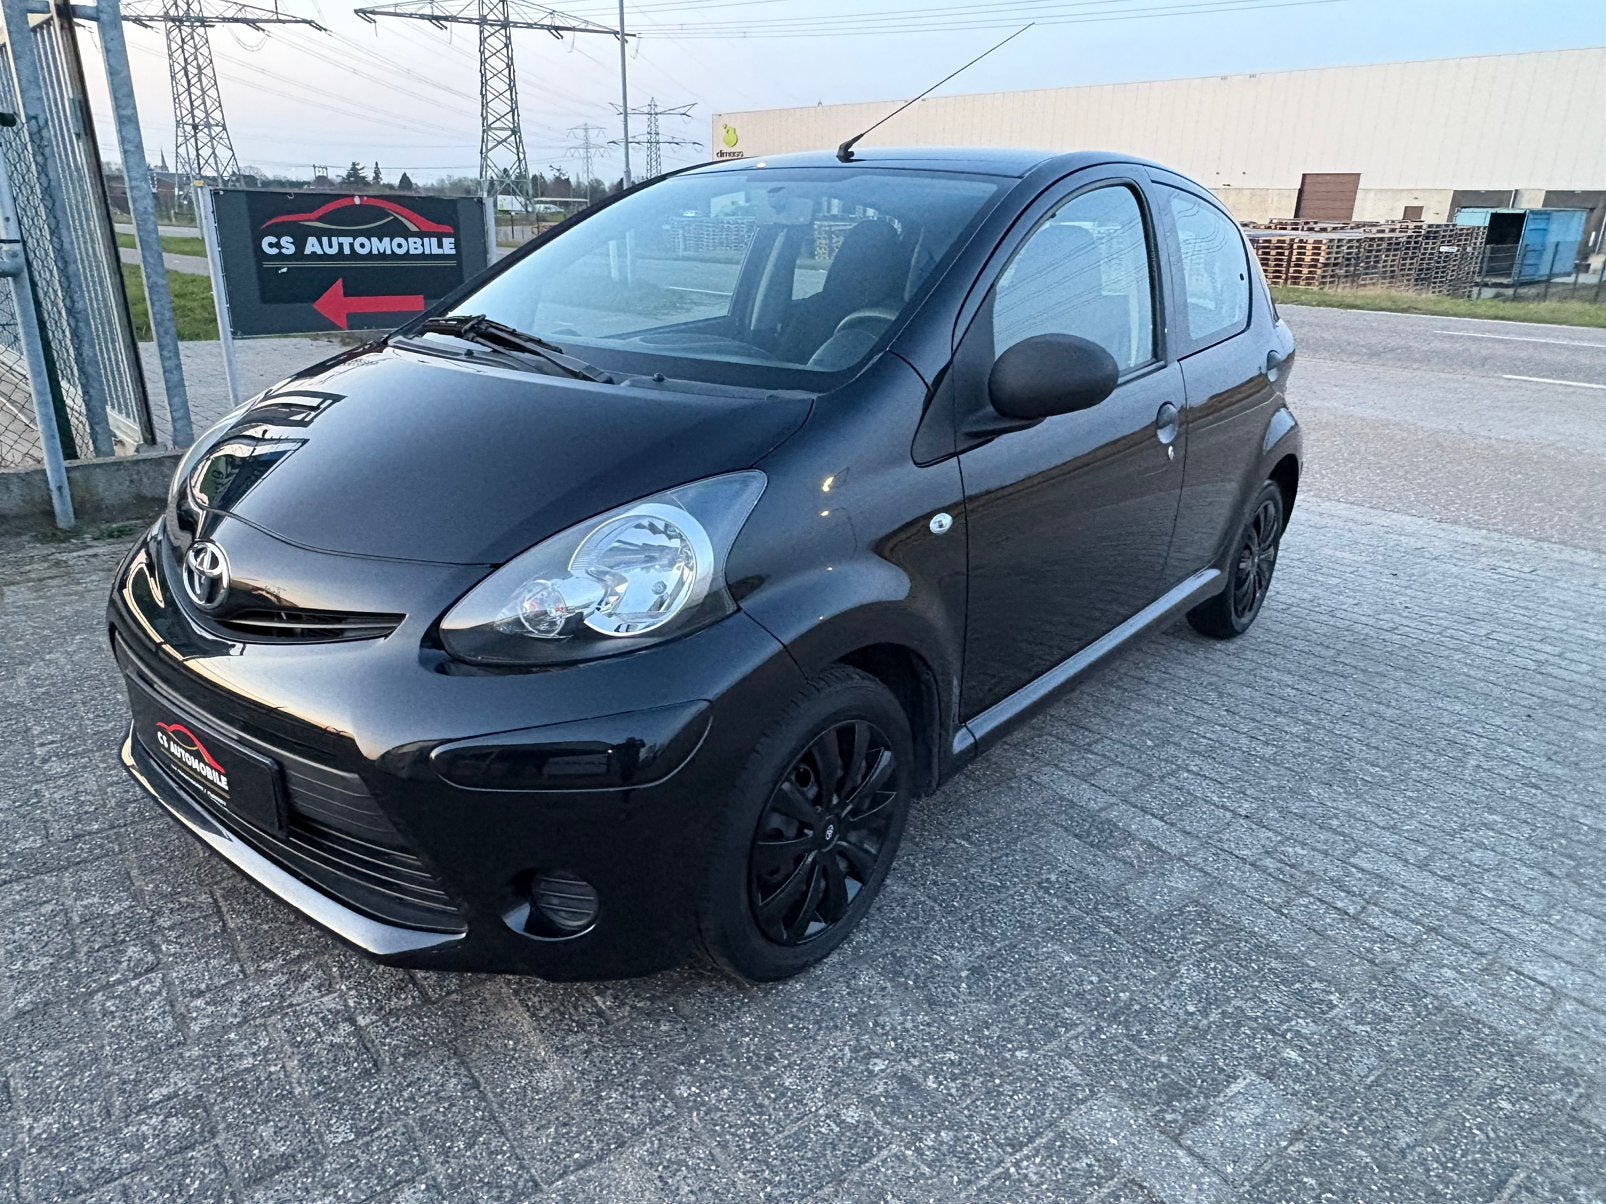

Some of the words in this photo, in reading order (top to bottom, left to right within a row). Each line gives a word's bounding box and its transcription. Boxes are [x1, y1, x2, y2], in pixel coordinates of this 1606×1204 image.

[261, 235, 296, 255] CS
[304, 236, 456, 255] AUTOMOBILE
[157, 731, 169, 748] CS
[170, 741, 229, 790] AUTOMOBILE
